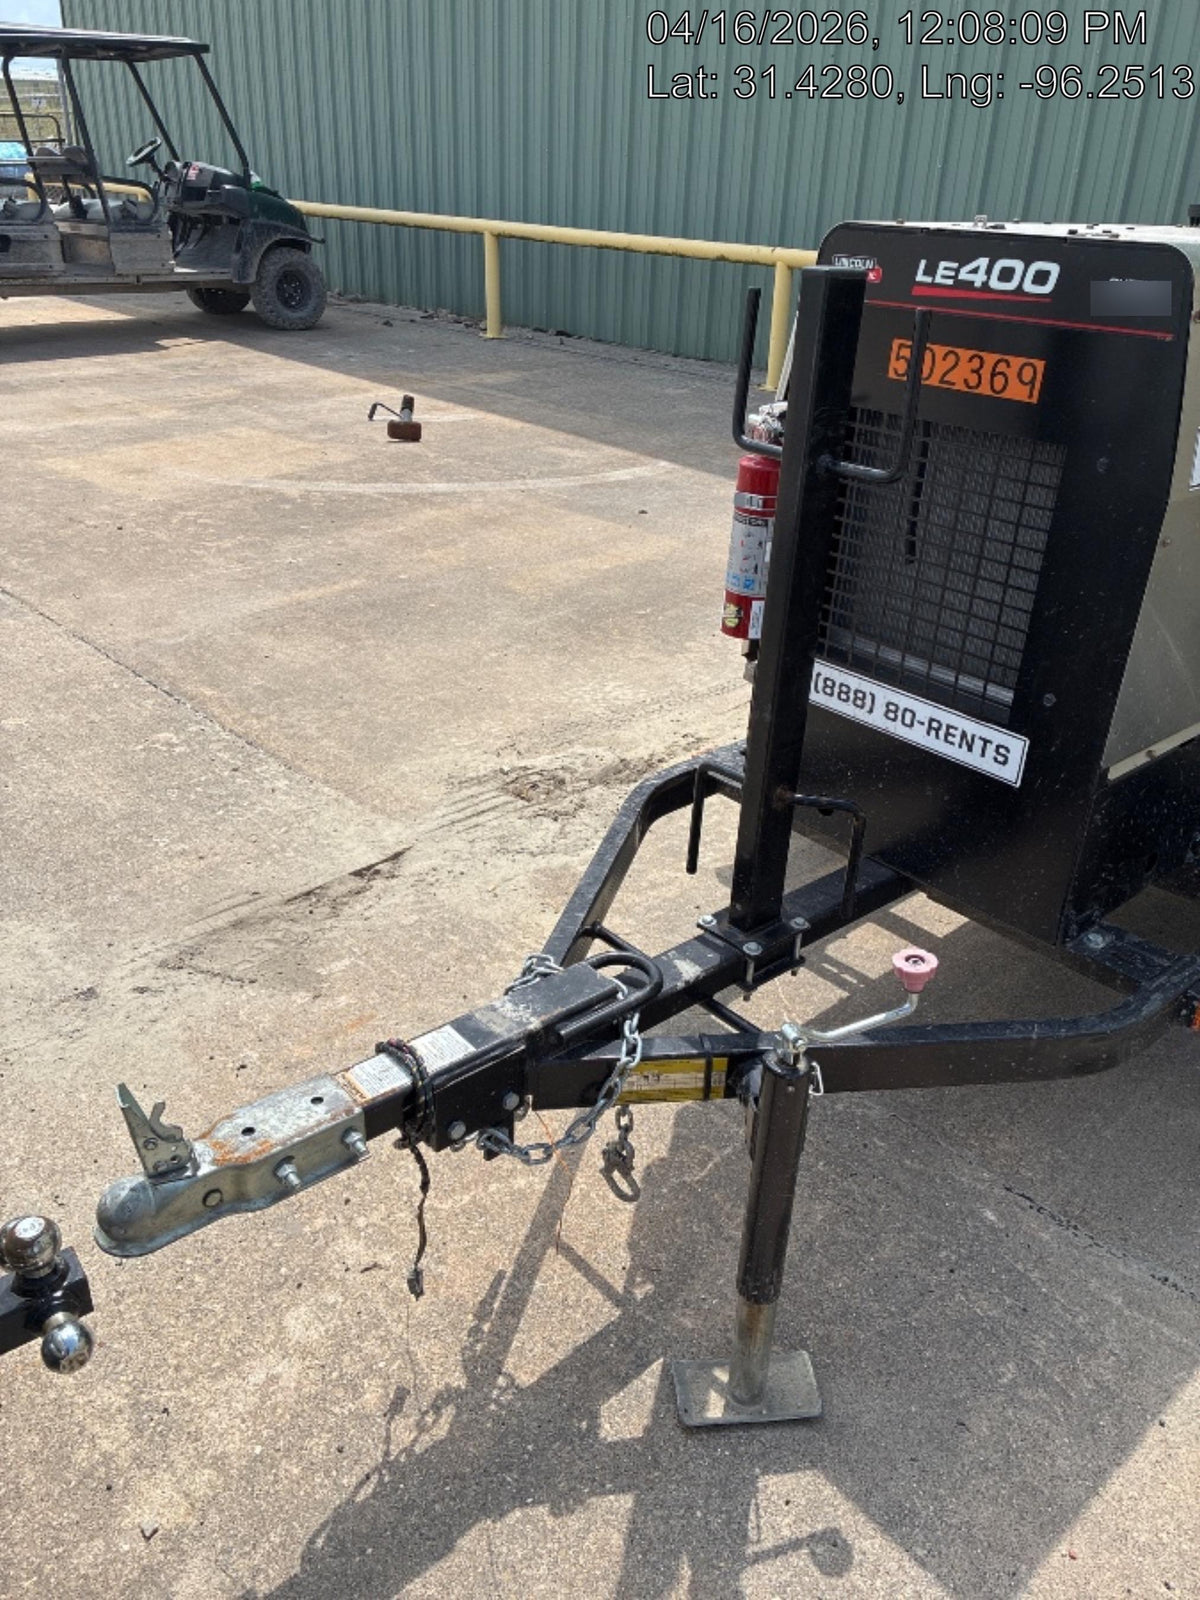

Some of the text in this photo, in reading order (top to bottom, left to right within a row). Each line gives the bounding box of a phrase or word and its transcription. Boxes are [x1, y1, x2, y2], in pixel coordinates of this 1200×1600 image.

[915, 257, 1061, 294] LE400
[813, 671, 1011, 767] (888) 80-RENTS
